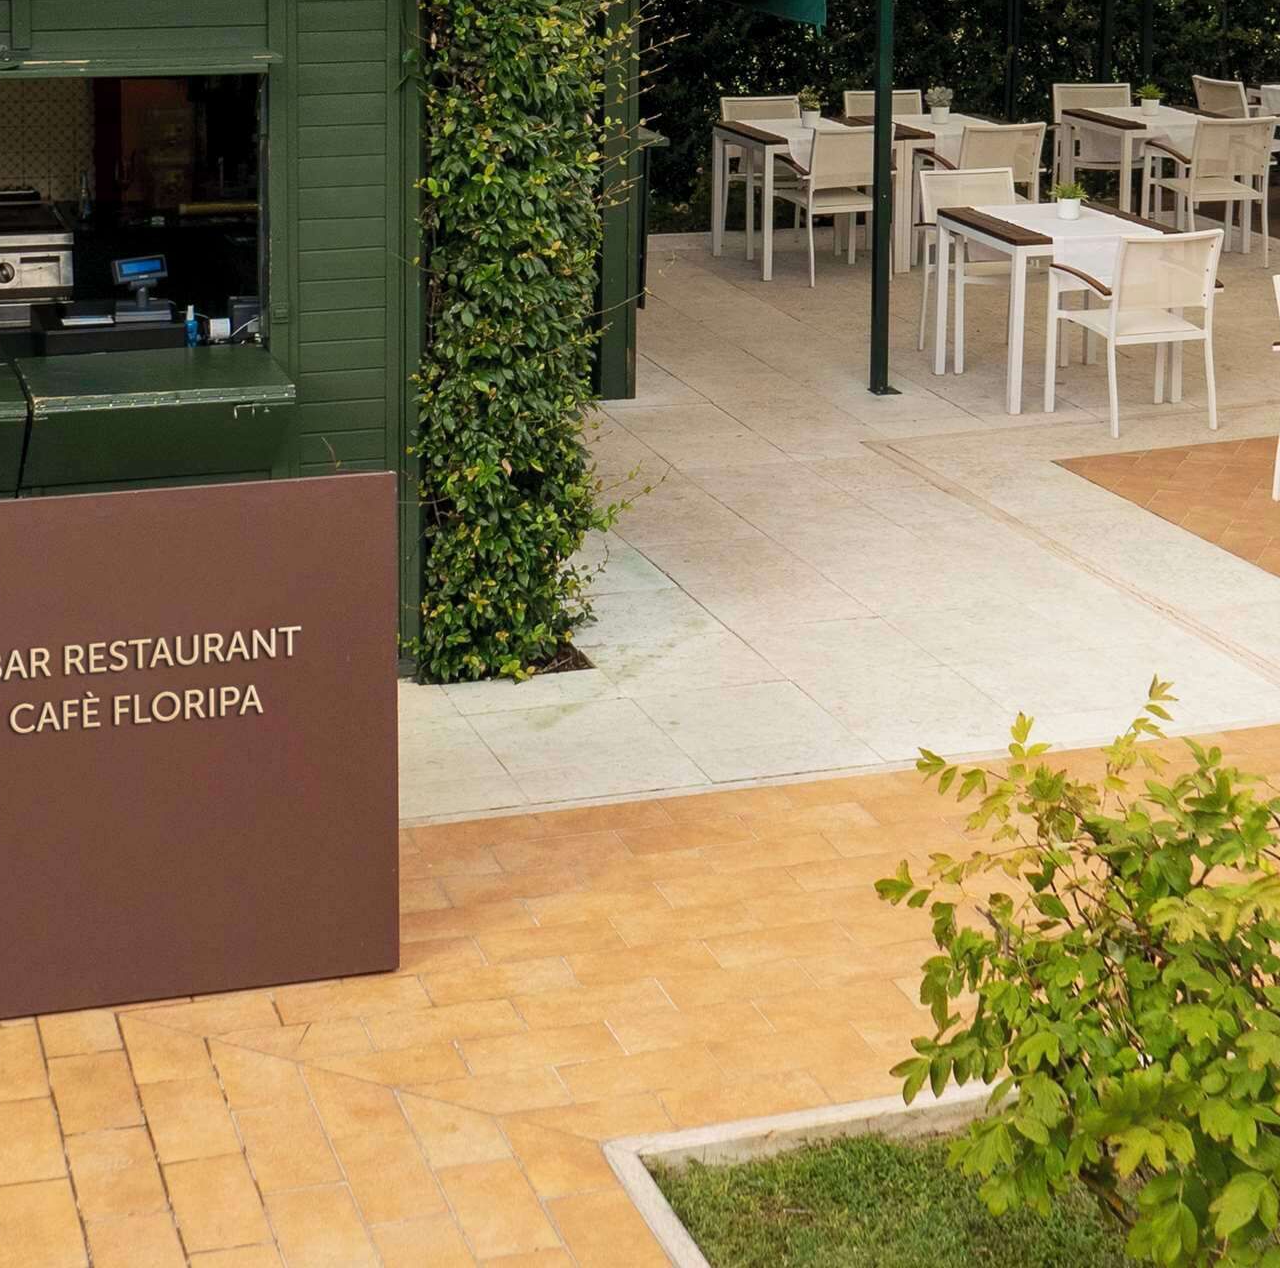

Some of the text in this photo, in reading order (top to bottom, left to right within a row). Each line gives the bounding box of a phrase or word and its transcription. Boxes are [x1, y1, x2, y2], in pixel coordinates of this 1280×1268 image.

[63, 625, 303, 676] RESTAURANT
[9, 684, 265, 735] CAFÈ FLORIPA
